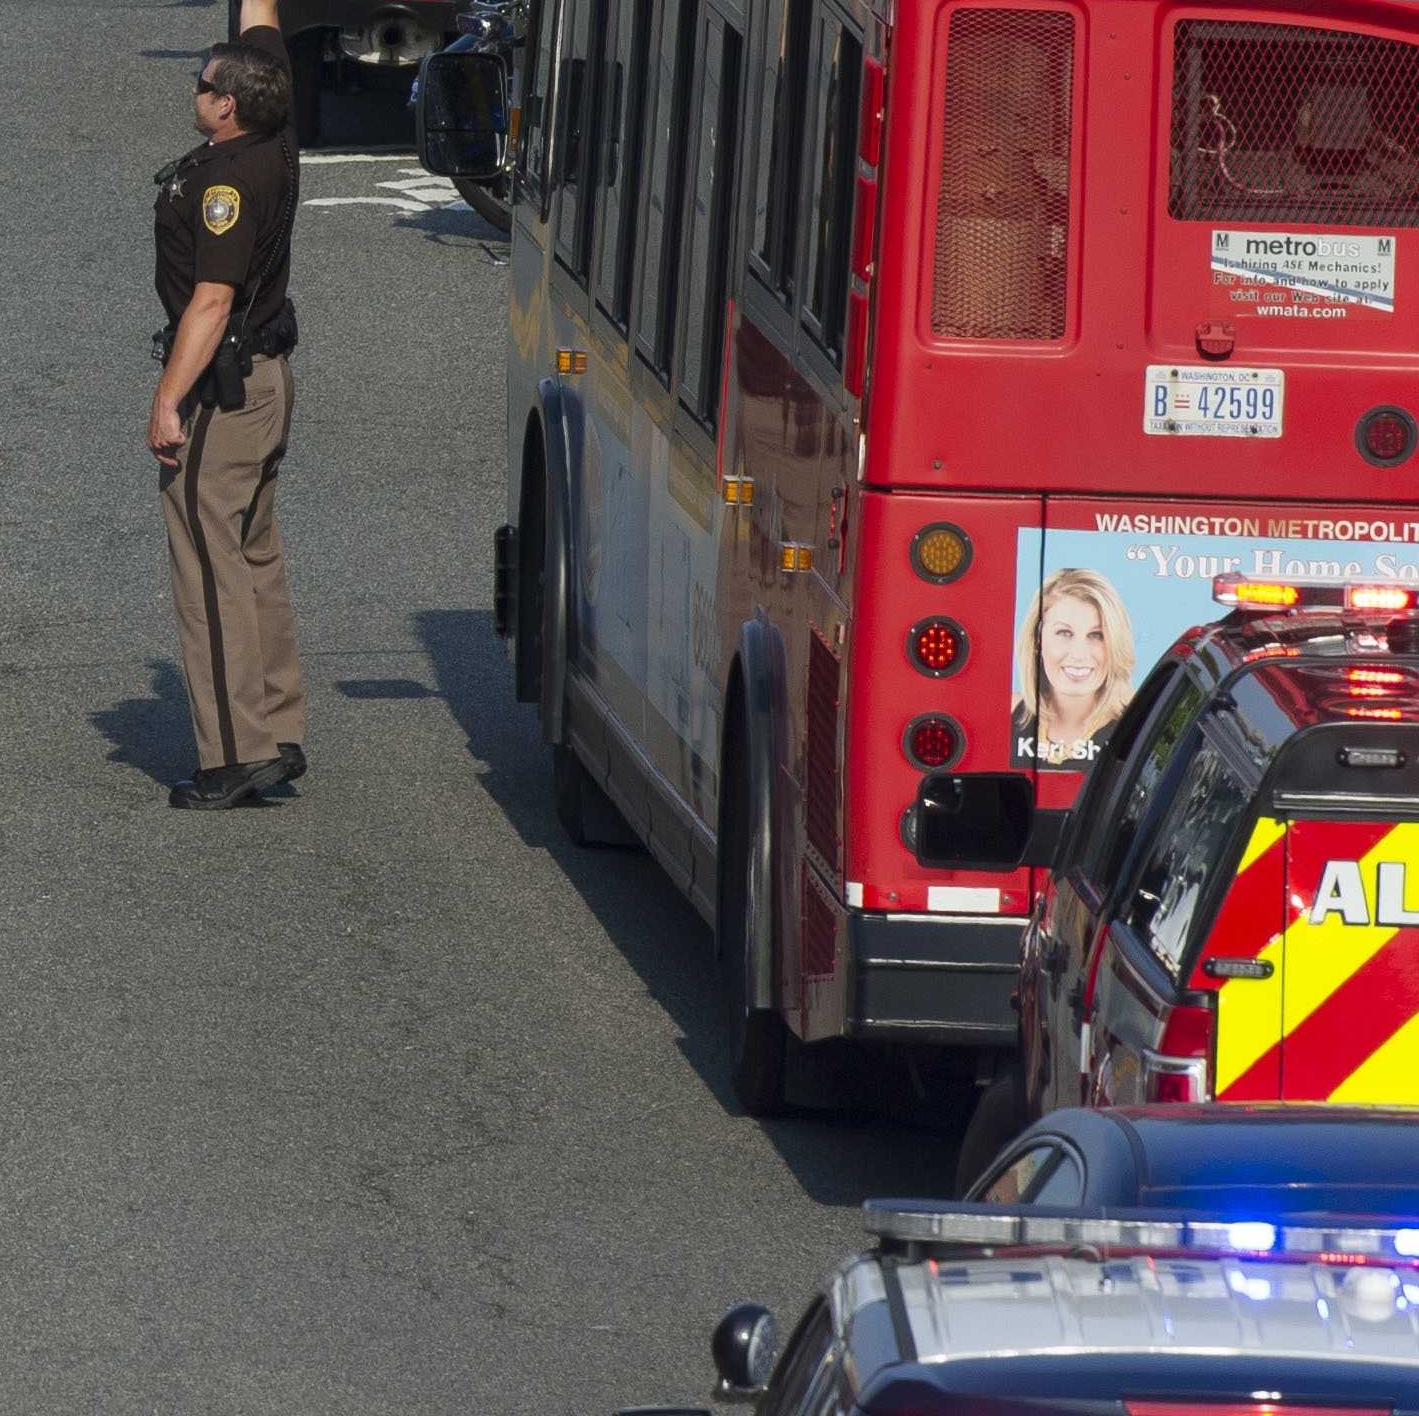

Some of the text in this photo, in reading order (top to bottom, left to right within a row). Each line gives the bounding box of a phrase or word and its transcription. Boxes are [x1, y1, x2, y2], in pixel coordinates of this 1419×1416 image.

[1217, 233, 1391, 258] M metrobus M
[1241, 259, 1278, 271] hiring
[1282, 260, 1304, 270] ASE
[1308, 261, 1381, 273] Mechanics!
[1214, 273, 1390, 291] For info and how to apply
[1230, 289, 1259, 301] visit
[1265, 292, 1286, 302] our
[1291, 291, 1319, 303] Web
[1325, 293, 1350, 304] site
[1257, 305, 1346, 318] wmata.com
[1154, 385, 1275, 420] B 42599
[1095, 513, 1260, 537] WASHINGTON
[1251, 549, 1362, 577] Home
[1308, 860, 1419, 927] AL
